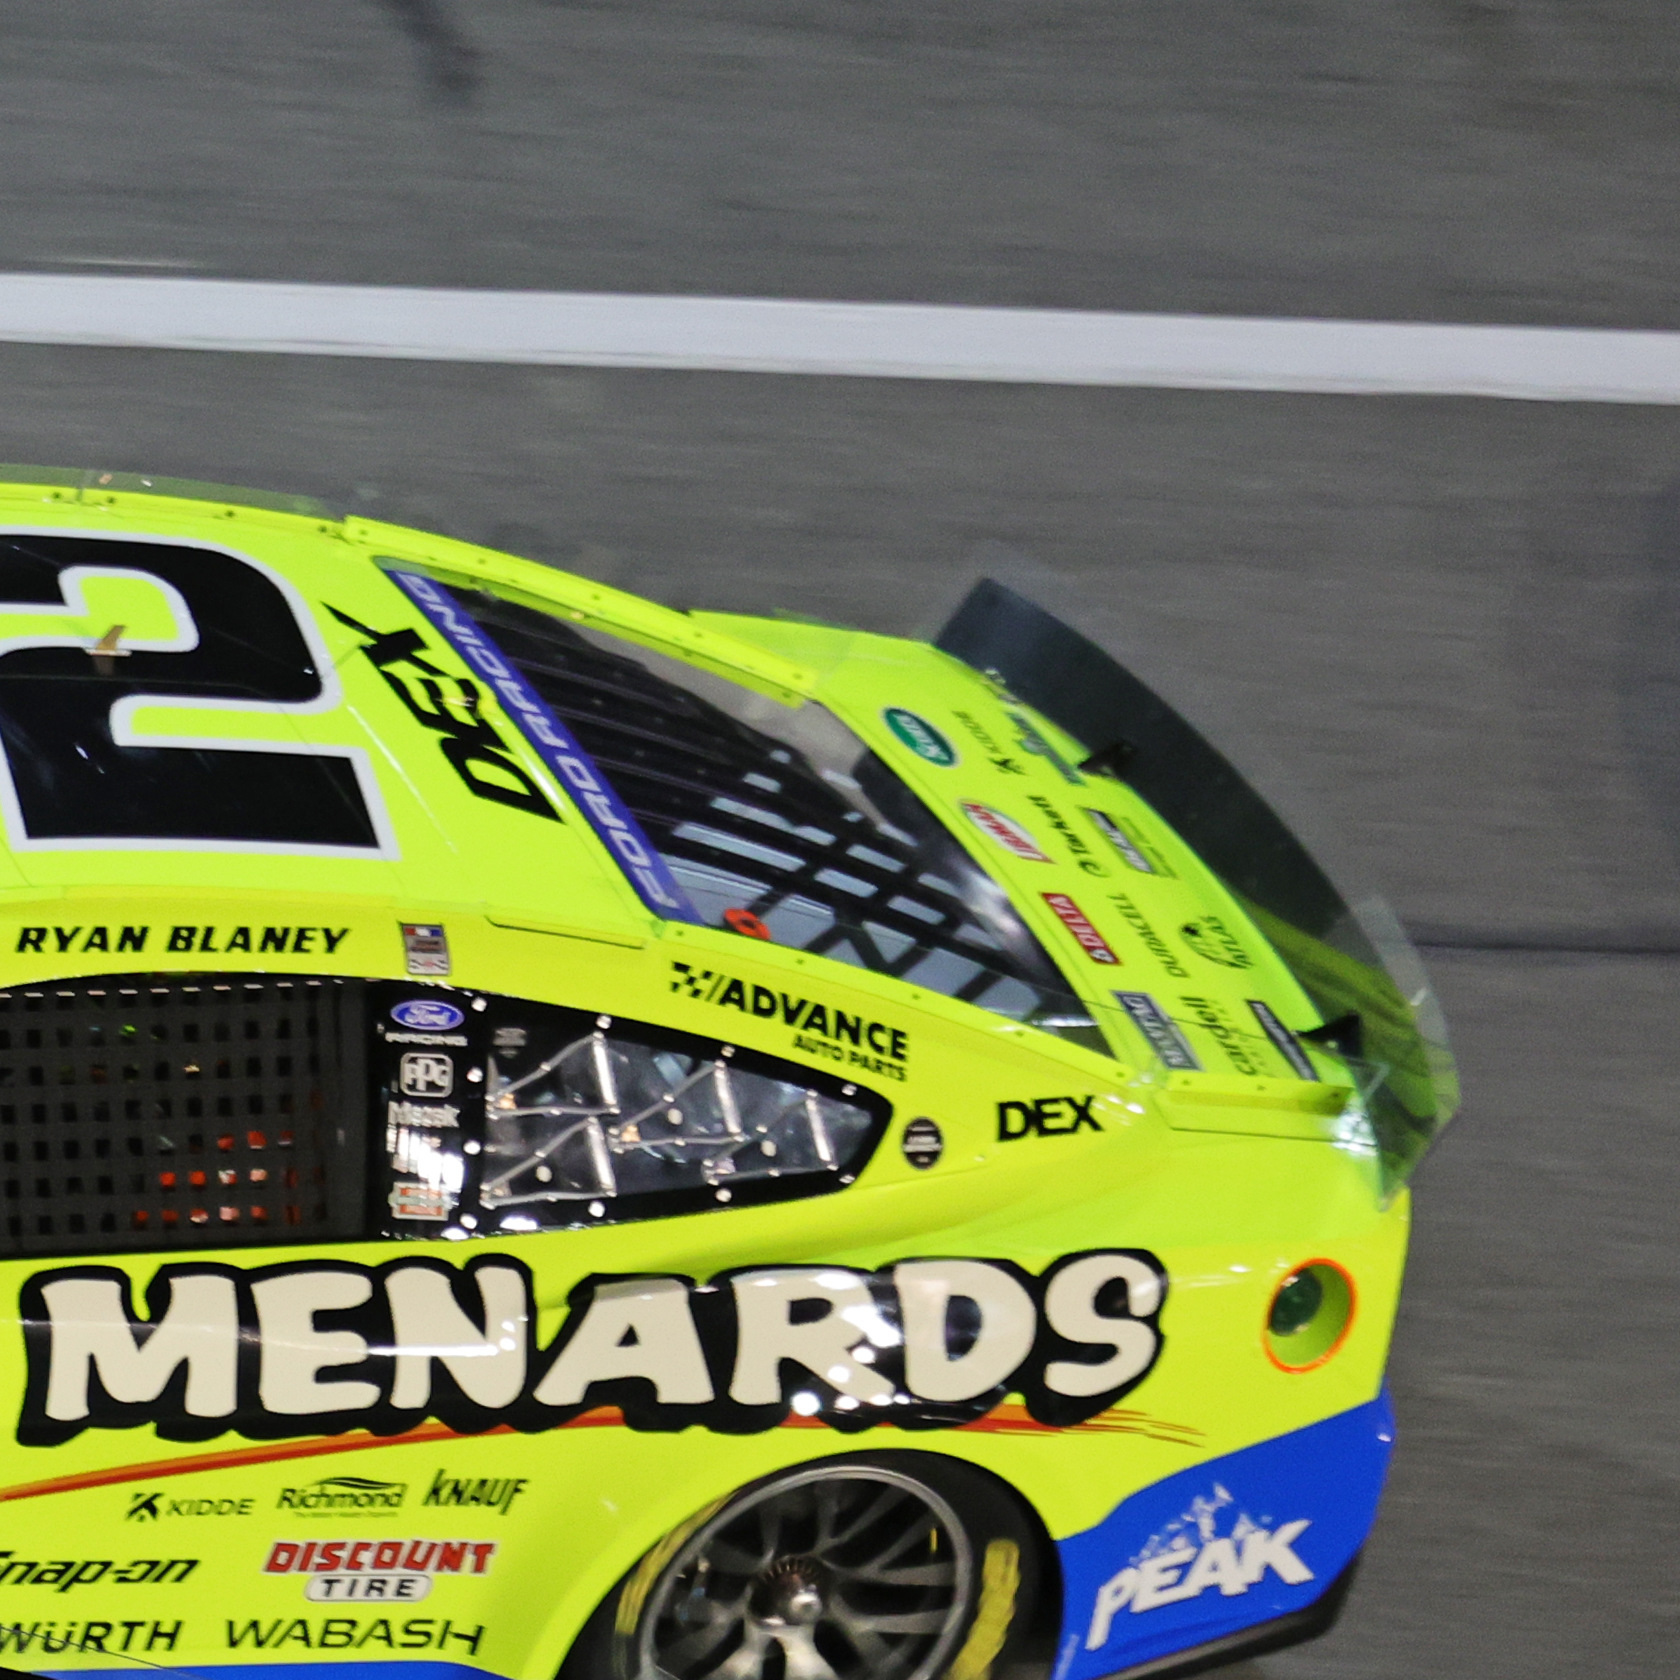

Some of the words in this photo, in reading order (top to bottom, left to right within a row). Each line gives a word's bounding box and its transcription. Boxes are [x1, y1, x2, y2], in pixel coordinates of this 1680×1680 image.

[399, 573, 569, 750] RACING
[324, 601, 564, 824] DEX
[555, 754, 679, 909] FORD
[16, 925, 148, 954] RYAN
[166, 926, 350, 955] BLANEY
[1047, 896, 1105, 950] DELTA
[1107, 893, 1189, 978] DURACELL
[718, 978, 909, 1061] ADVANCE
[405, 1057, 452, 1093] PPG
[793, 1032, 843, 1063] AUTO
[848, 1050, 907, 1083] PARTS
[997, 1095, 1104, 1141] DEX
[17, 1249, 1168, 1447] MENARDS
[166, 1498, 255, 1516] KIDDE
[277, 1482, 407, 1509] Richmond
[423, 1469, 528, 1516] KNAUF
[263, 1540, 498, 1574] DISCOUNT
[322, 1578, 417, 1598] TIRE
[1087, 1519, 1314, 1650] PEAK
[225, 1619, 485, 1656] WABASH
